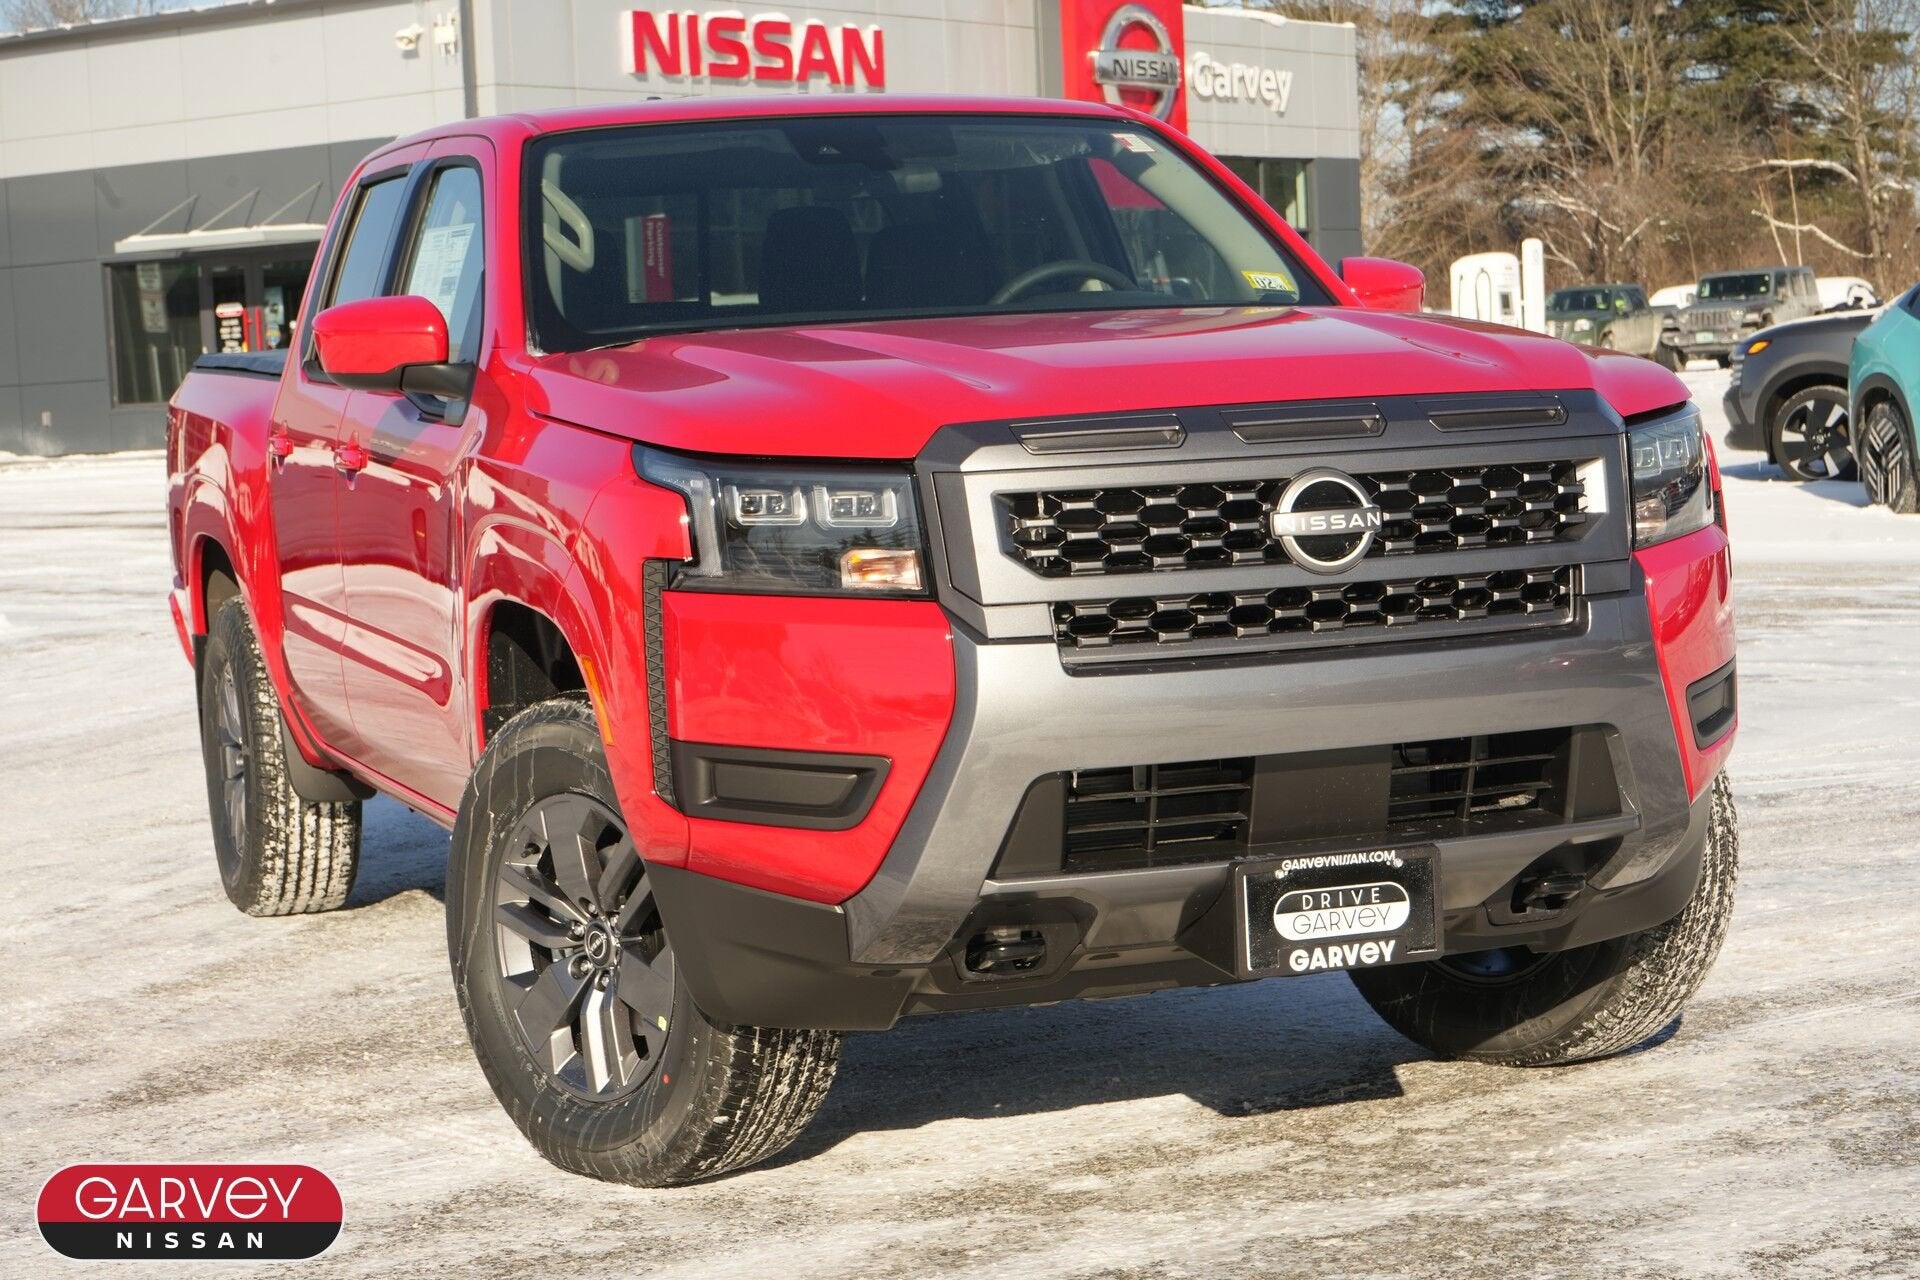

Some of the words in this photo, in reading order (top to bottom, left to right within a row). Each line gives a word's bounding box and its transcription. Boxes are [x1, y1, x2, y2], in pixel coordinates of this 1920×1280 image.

[630, 11, 884, 87] NISSAN
[1112, 58, 1177, 80] NISSAN
[1192, 52, 1292, 113] Garvey
[1278, 511, 1381, 532] NISSAN
[1302, 887, 1380, 910] DRIVE
